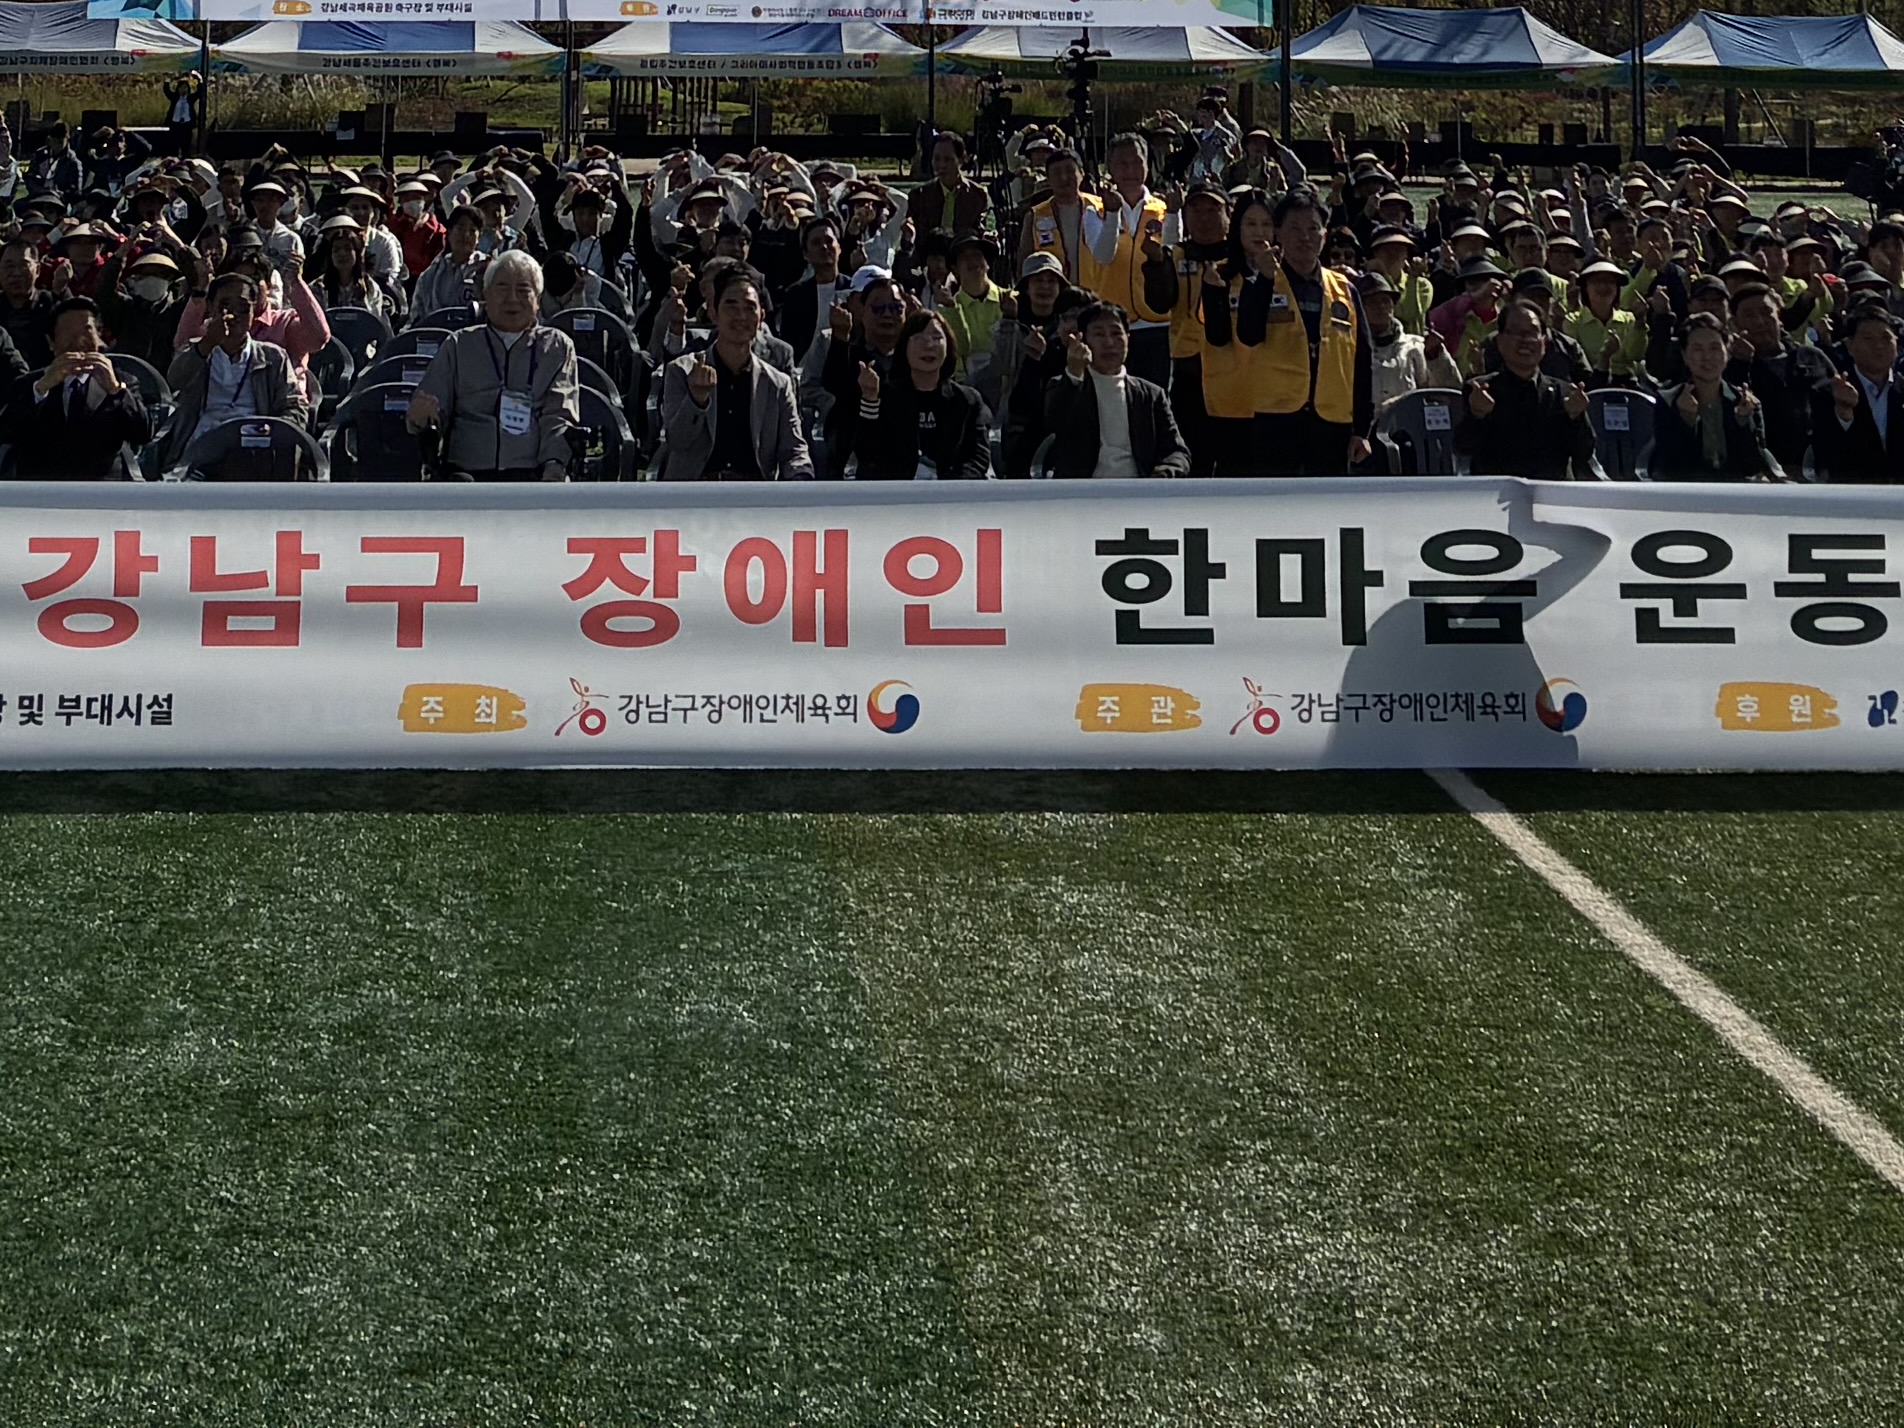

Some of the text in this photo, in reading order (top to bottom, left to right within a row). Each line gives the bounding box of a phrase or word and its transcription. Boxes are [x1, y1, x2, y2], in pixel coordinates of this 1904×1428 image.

[20, 528, 480, 650] 강남구
[561, 528, 1008, 650] 장애인
[1094, 526, 1539, 648] 한마음
[17, 694, 45, 727] 및
[53, 693, 176, 728] 부대시설
[617, 692, 859, 727] 강남구장애인체육회
[1289, 689, 1528, 726] 강남구장애인체육회
